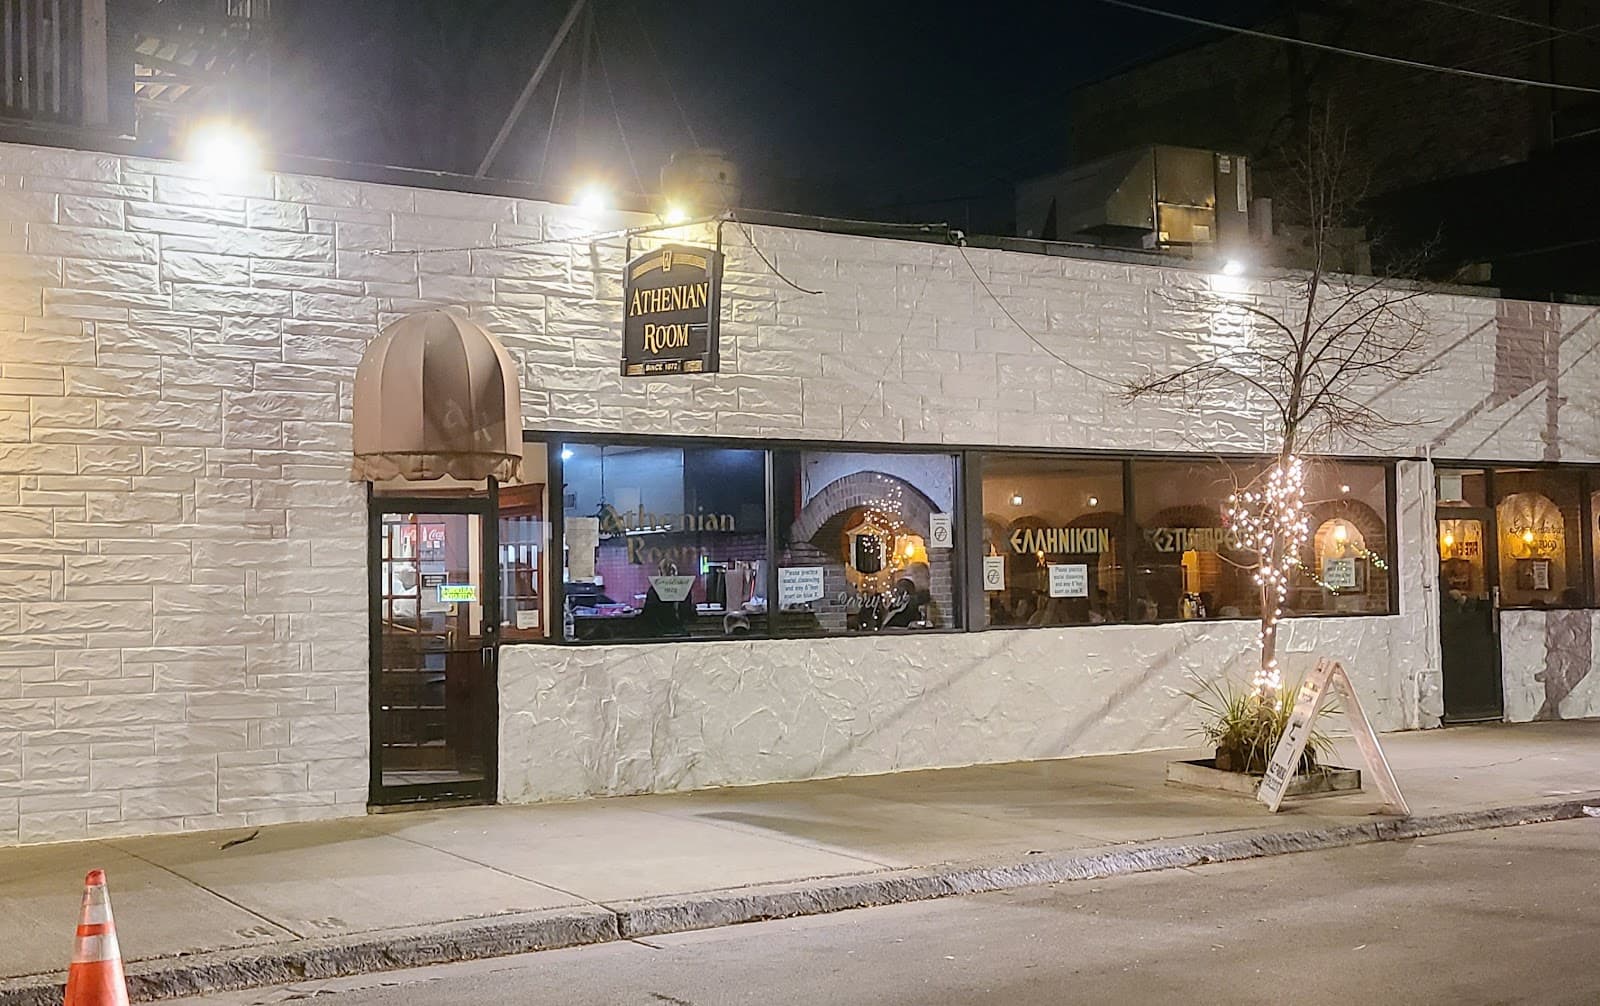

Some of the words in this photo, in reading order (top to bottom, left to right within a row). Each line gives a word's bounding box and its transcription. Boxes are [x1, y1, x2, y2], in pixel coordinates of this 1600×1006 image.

[629, 282, 708, 317] ATHENIAN
[644, 323, 689, 354] ROOM
[645, 363, 663, 372] SINCE
[838, 591, 880, 616] Carry
